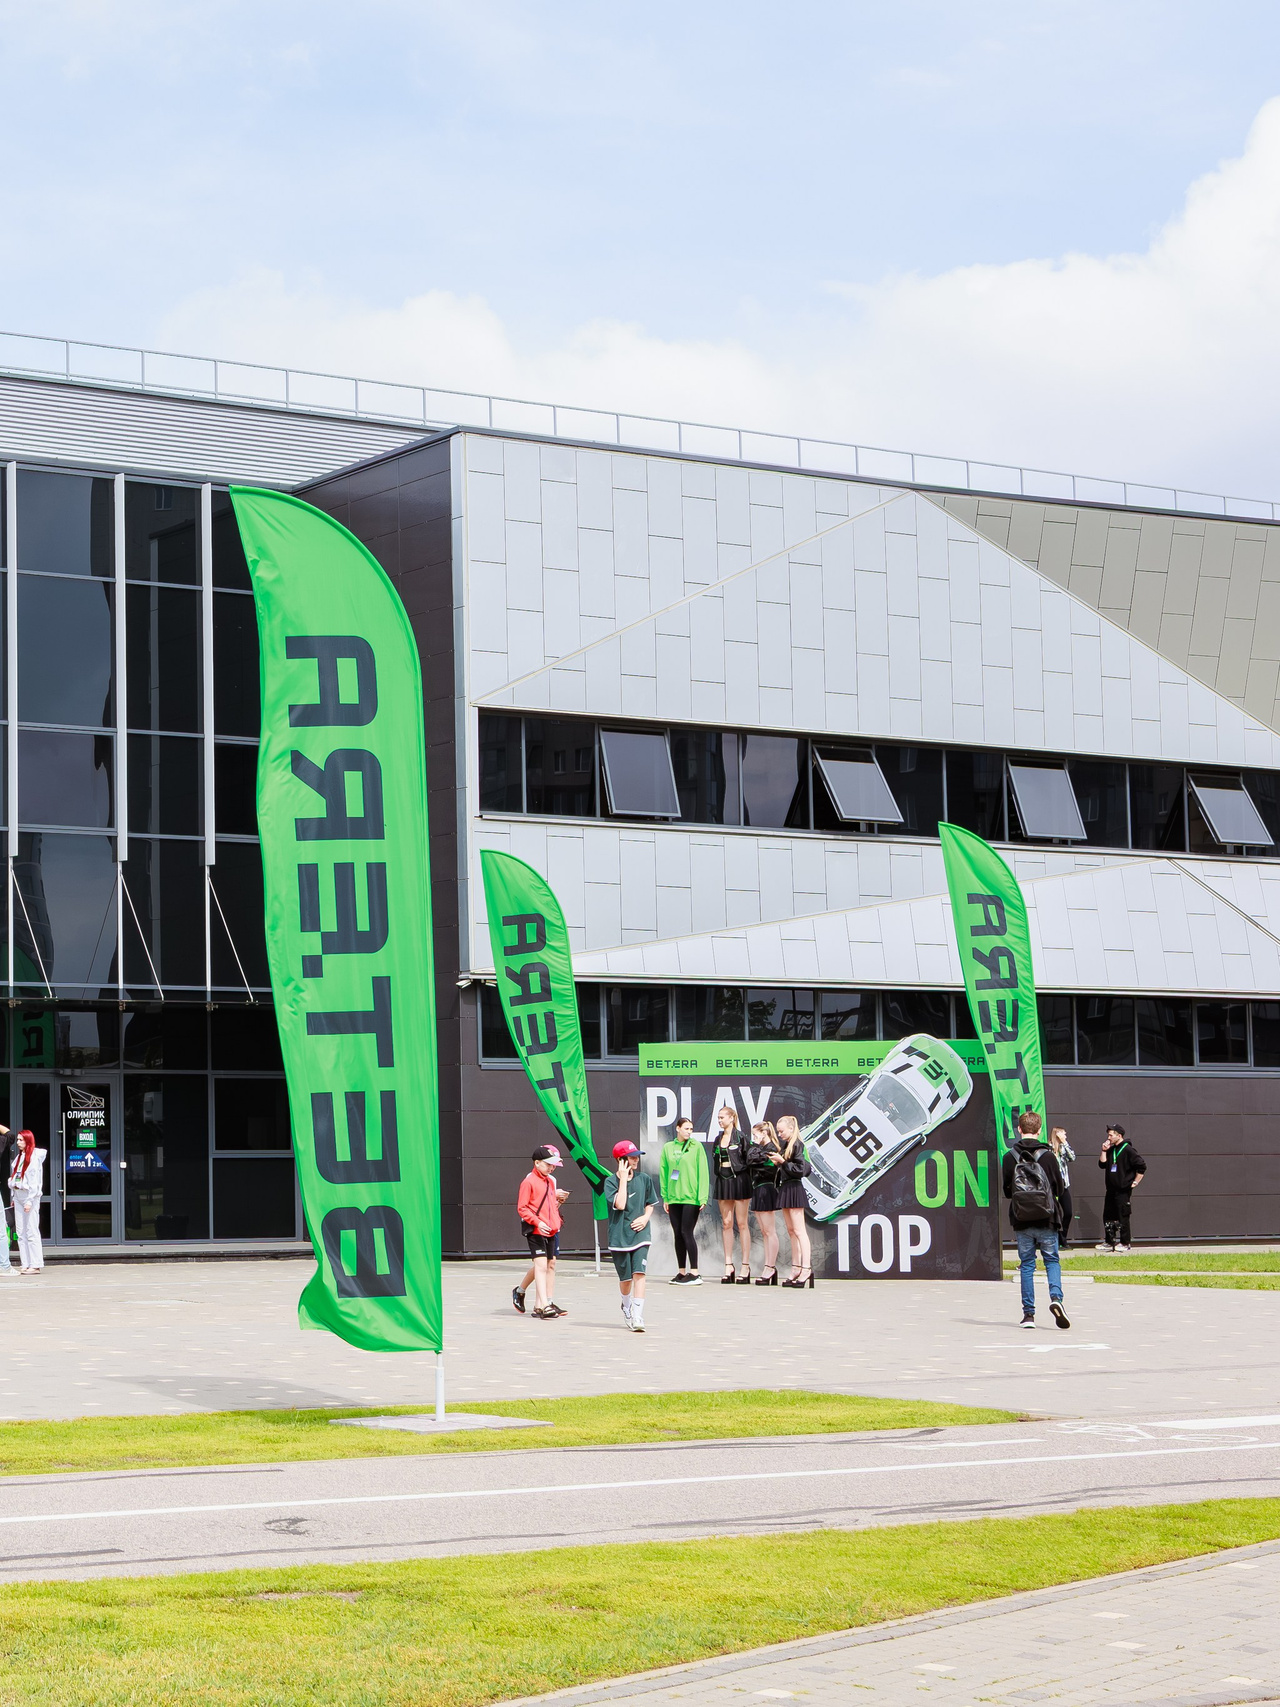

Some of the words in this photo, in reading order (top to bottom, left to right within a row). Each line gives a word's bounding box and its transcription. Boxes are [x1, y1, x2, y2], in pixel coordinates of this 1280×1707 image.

[67, 1110, 105, 1119] ОЛИМПИК
[80, 1119, 105, 1127] АРЕНА
[646, 1086, 772, 1143] PLAY
[79, 1133, 94, 1141] ВХОД
[914, 1149, 989, 1208] ON
[827, 1213, 932, 1273] TOP
